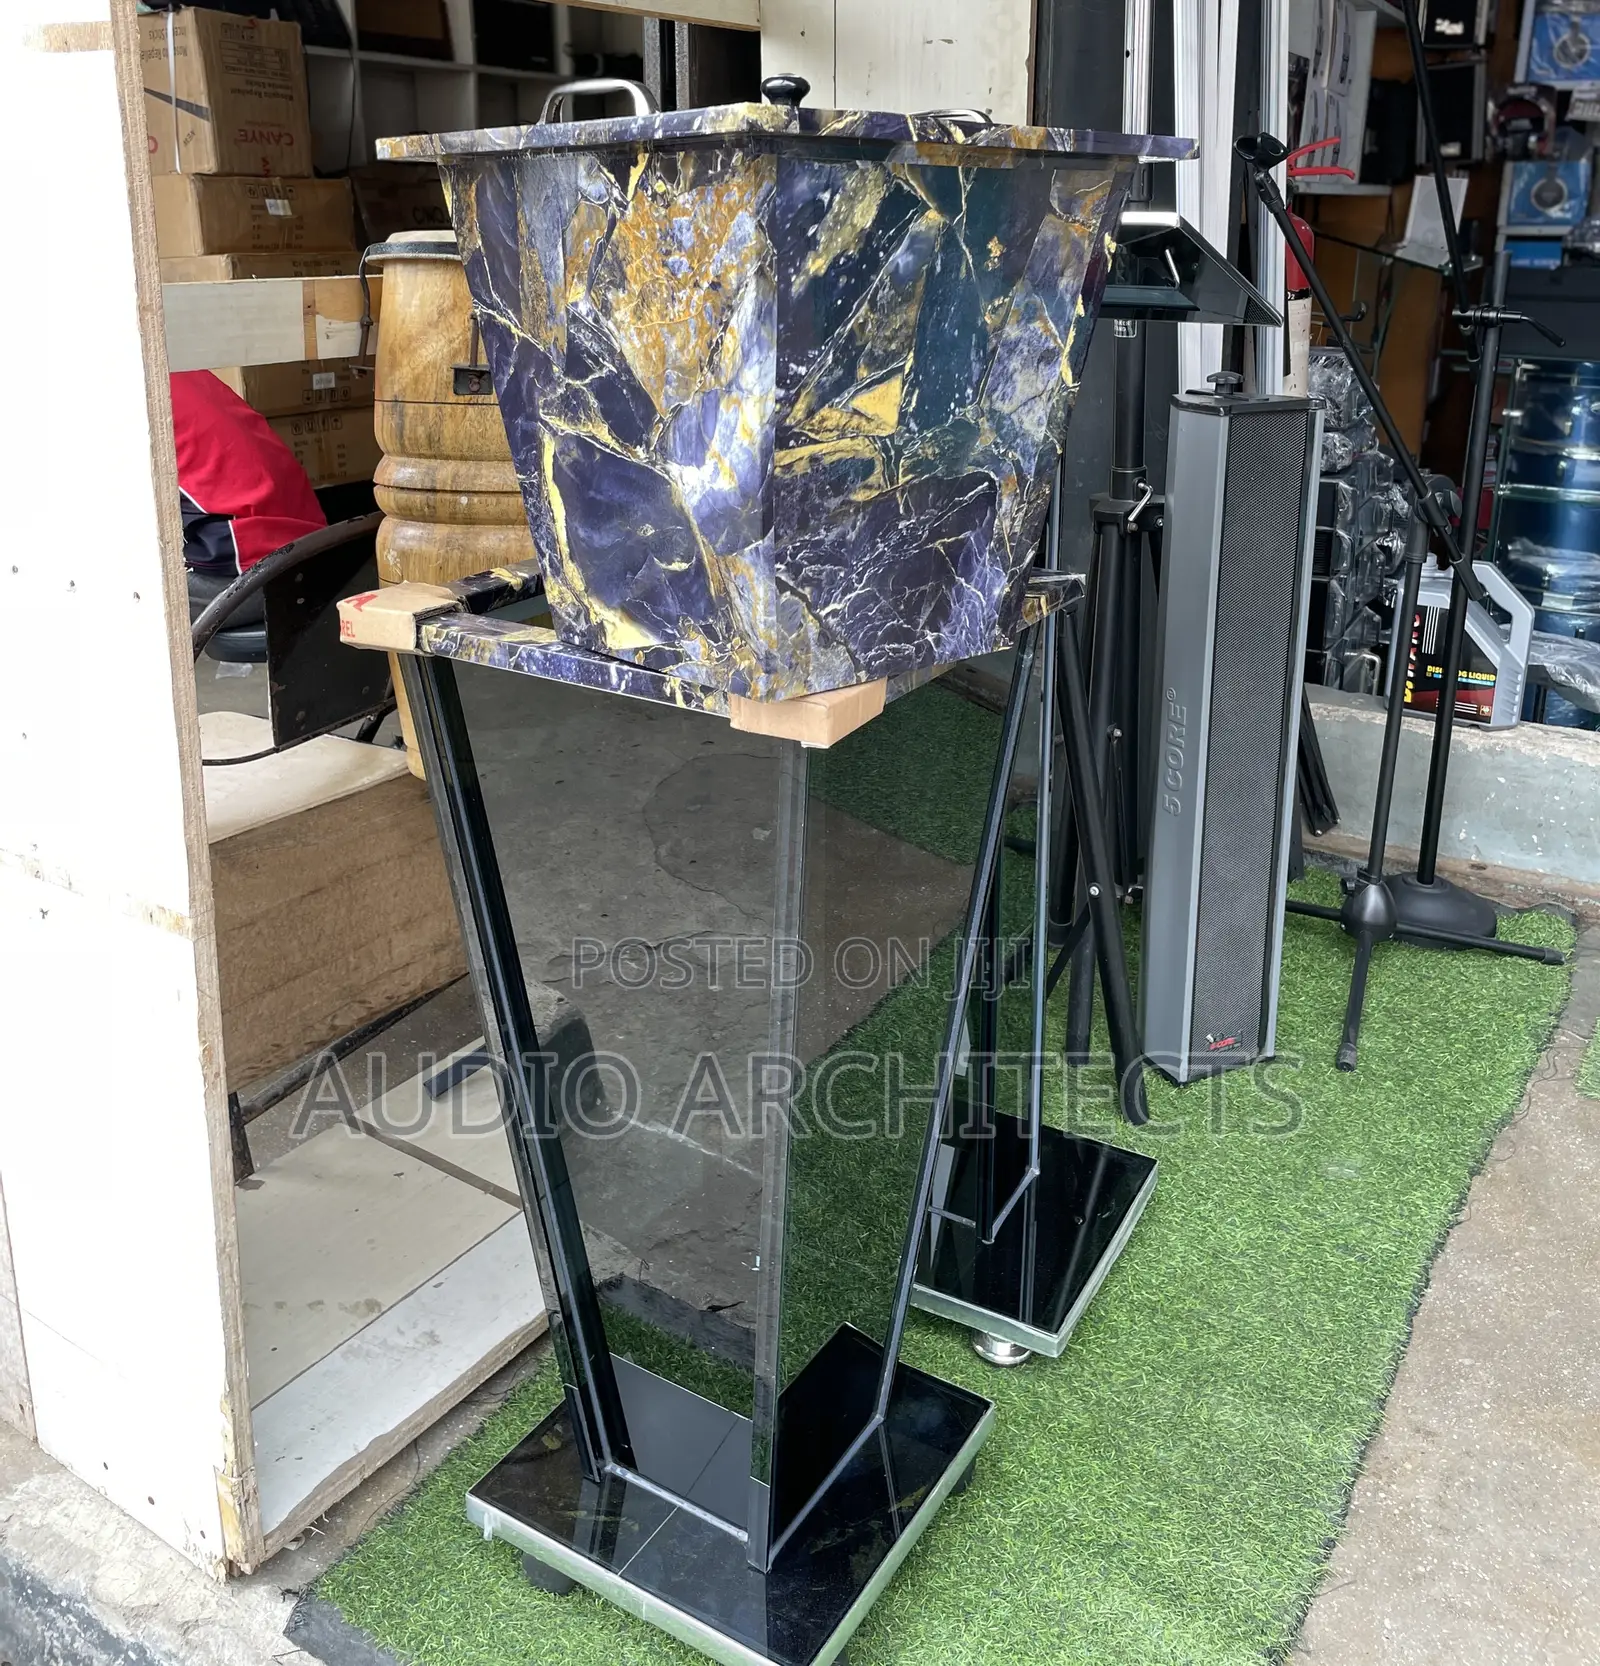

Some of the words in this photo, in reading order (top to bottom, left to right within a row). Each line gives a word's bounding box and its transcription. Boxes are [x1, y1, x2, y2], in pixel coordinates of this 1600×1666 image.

[182, 129, 196, 148] NEW
[237, 128, 294, 147] CANYE
[1468, 671, 1496, 682] LIQUID
[1162, 794, 1182, 817] 5
